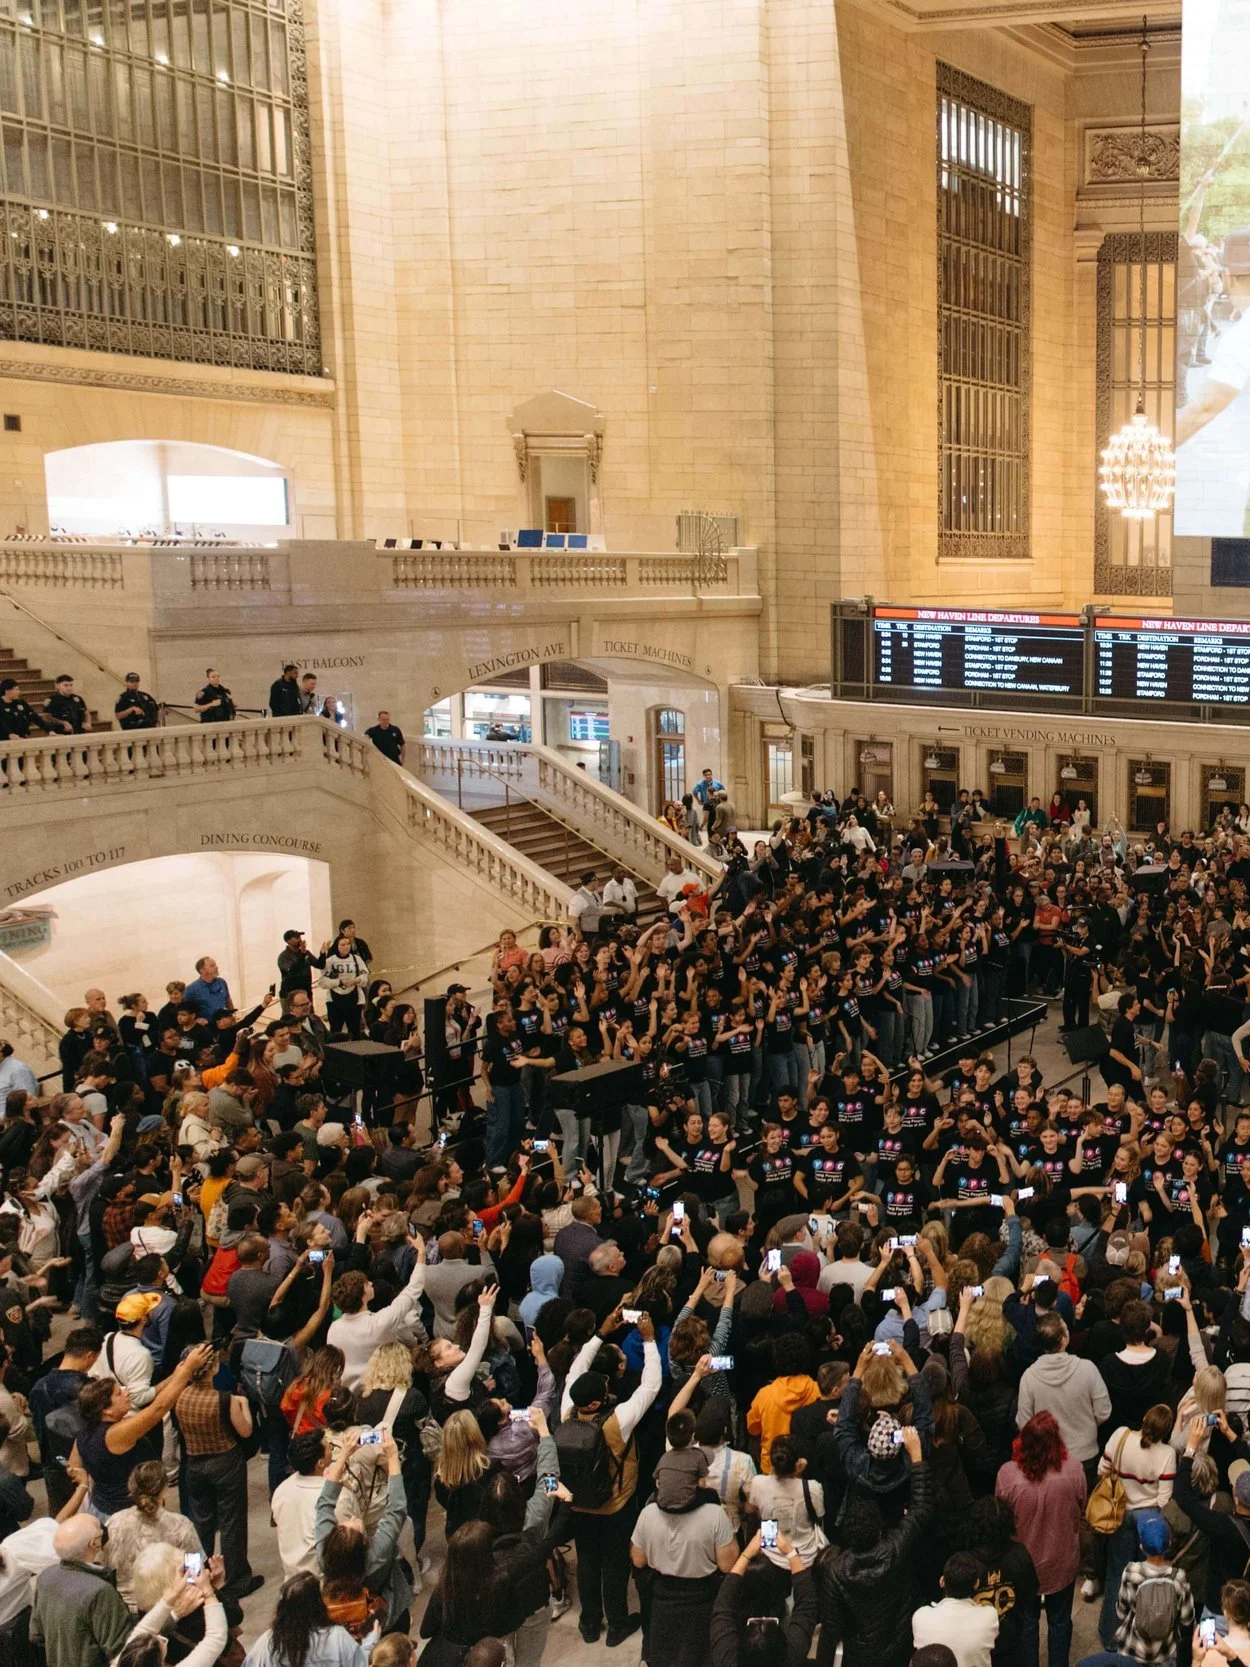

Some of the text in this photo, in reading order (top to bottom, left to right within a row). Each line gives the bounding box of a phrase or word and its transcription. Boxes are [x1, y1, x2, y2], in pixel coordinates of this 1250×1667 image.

[918, 610, 1040, 623] NEW HAVEN LINE DEPARTURES
[1164, 621, 1194, 631] HAVEN
[1196, 623, 1217, 632] LINE
[281, 655, 367, 670] EAST BALCONY
[468, 642, 565, 680] LEXINGTON AVE
[603, 640, 693, 667] TICKET MACHINES
[962, 726, 1116, 745] TICKET VENDING MACHINES
[200, 834, 322, 853] DINING CONCOURSE
[4, 847, 126, 897] TRACKS 100 TO 117
